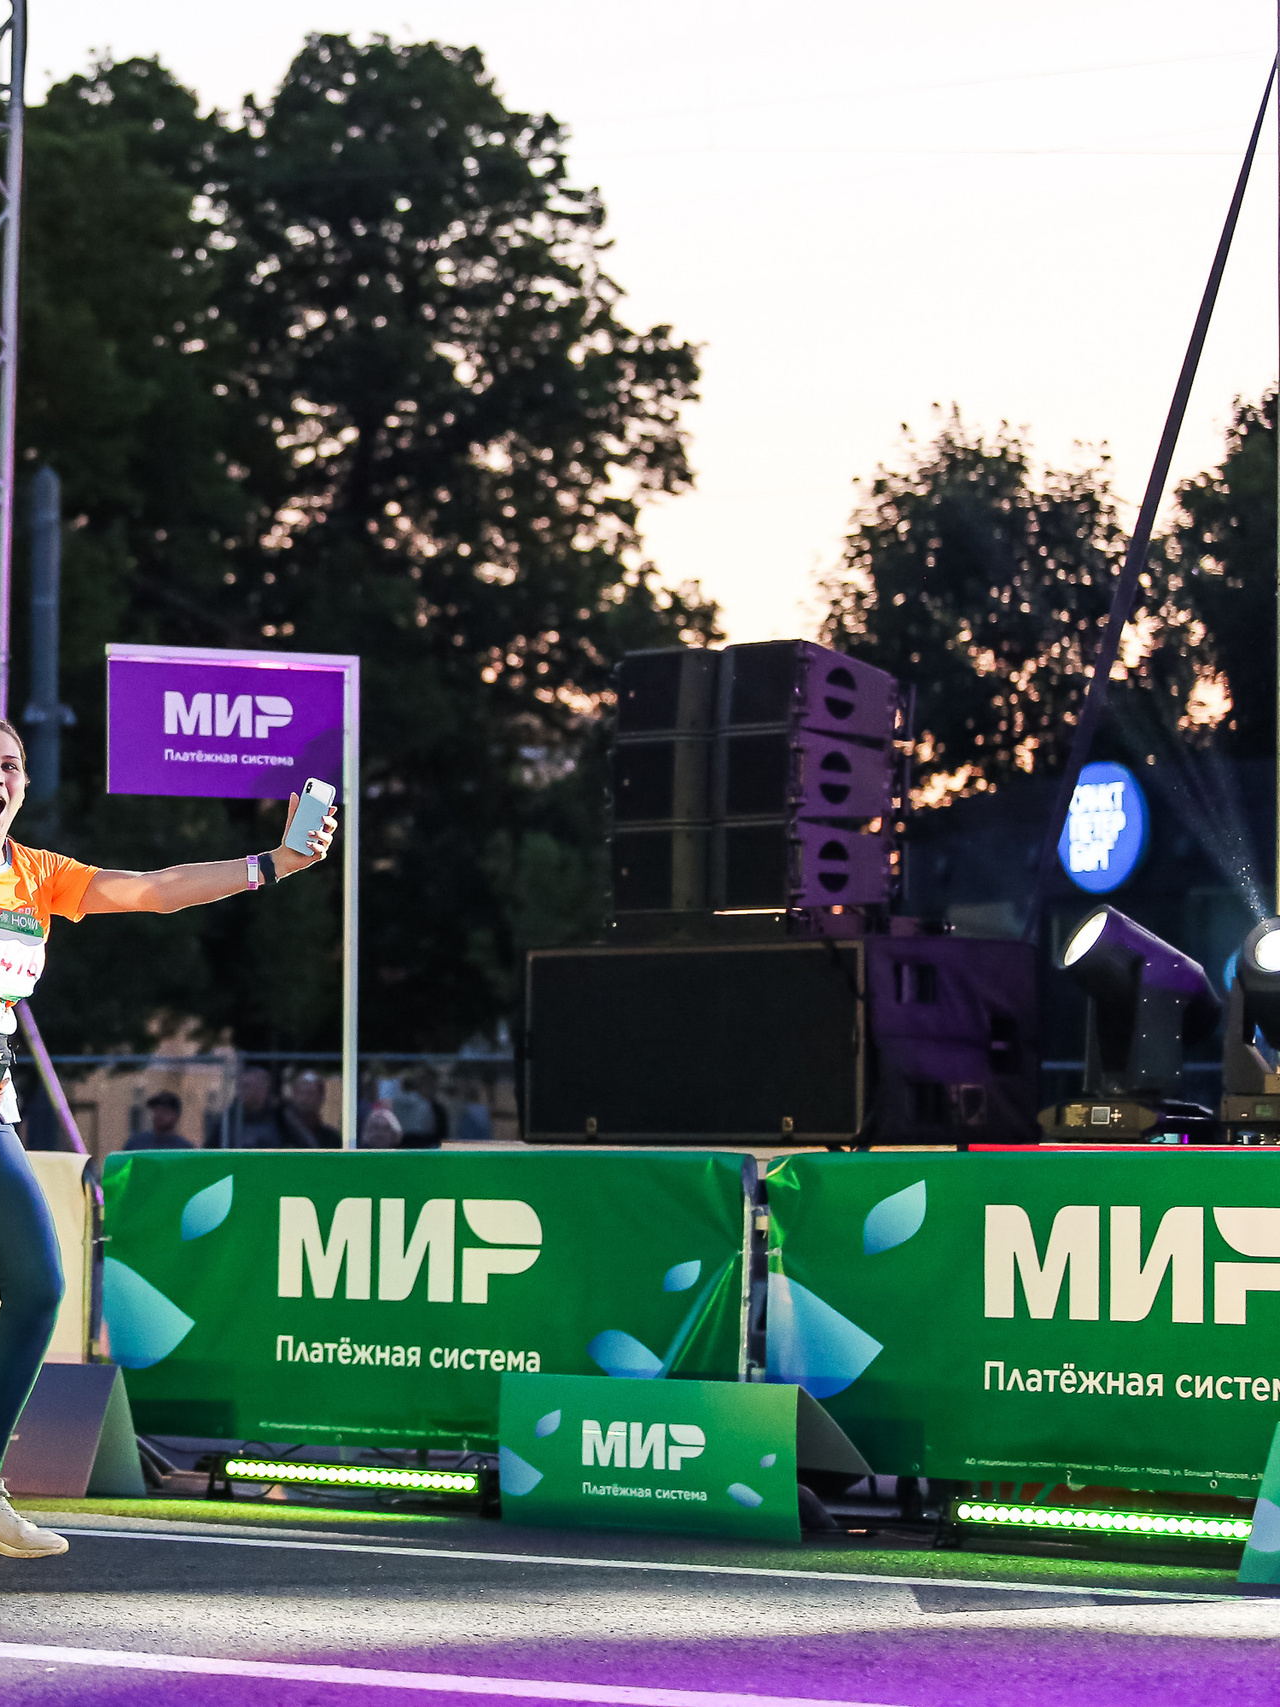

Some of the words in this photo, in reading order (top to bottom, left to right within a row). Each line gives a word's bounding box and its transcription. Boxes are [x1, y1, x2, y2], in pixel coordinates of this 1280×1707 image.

[164, 691, 294, 738] МИР
[164, 749, 238, 764] Платёжная
[241, 755, 294, 766] система
[278, 1196, 543, 1304] МИР
[984, 1204, 1280, 1325] МИР
[276, 1334, 422, 1367] Платёжная
[429, 1346, 542, 1373] система
[983, 1361, 1164, 1397] Платёжная
[582, 1419, 706, 1471] МИР
[582, 1481, 652, 1498] Платёжная
[655, 1487, 707, 1501] система
